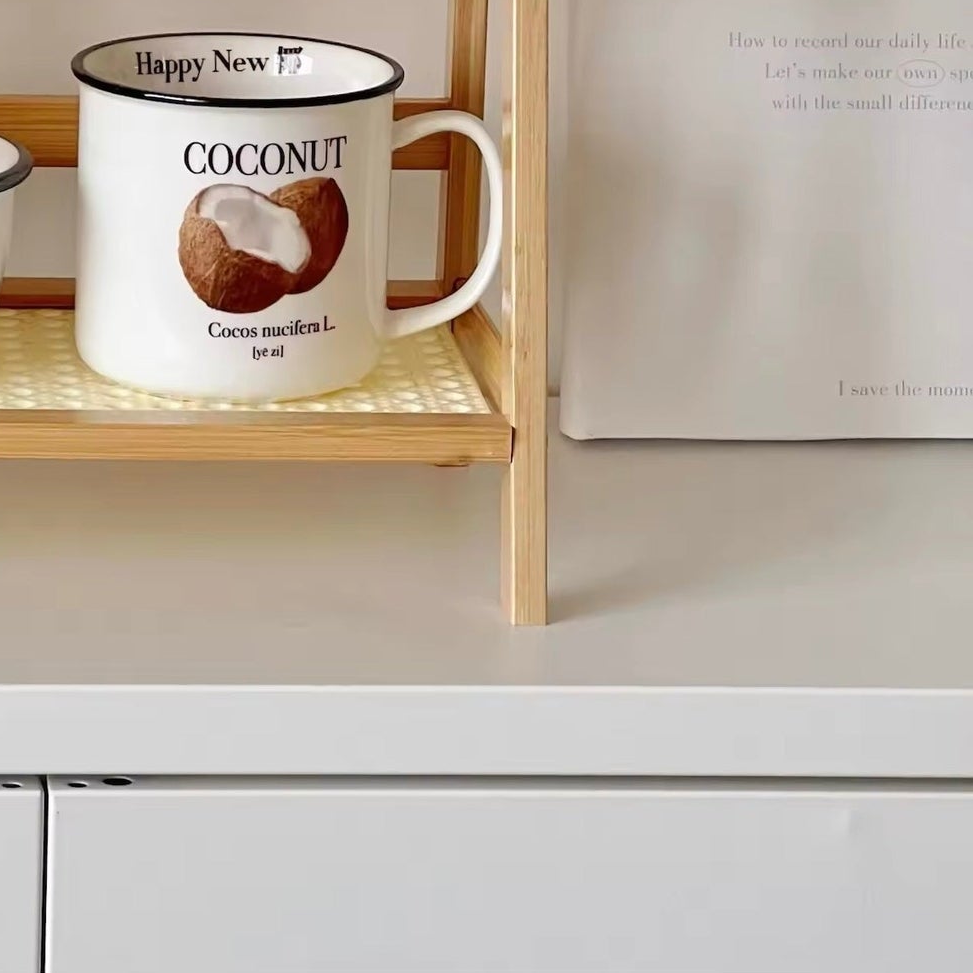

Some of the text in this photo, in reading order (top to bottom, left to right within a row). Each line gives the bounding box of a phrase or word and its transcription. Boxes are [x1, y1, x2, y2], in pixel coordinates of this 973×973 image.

[728, 31, 967, 53] How to record our daily life
[134, 51, 206, 83] Happy
[212, 48, 270, 74] New
[765, 61, 807, 80] Let's
[812, 61, 860, 80] make
[864, 67, 893, 80] our
[903, 67, 939, 80] own
[772, 93, 808, 111] with
[813, 93, 841, 111] the
[846, 93, 893, 111] small
[183, 135, 348, 176] COCONUT
[208, 321, 258, 338] Cocos
[261, 319, 321, 337] nucifera
[850, 384, 889, 396] save
[894, 379, 924, 396] the
